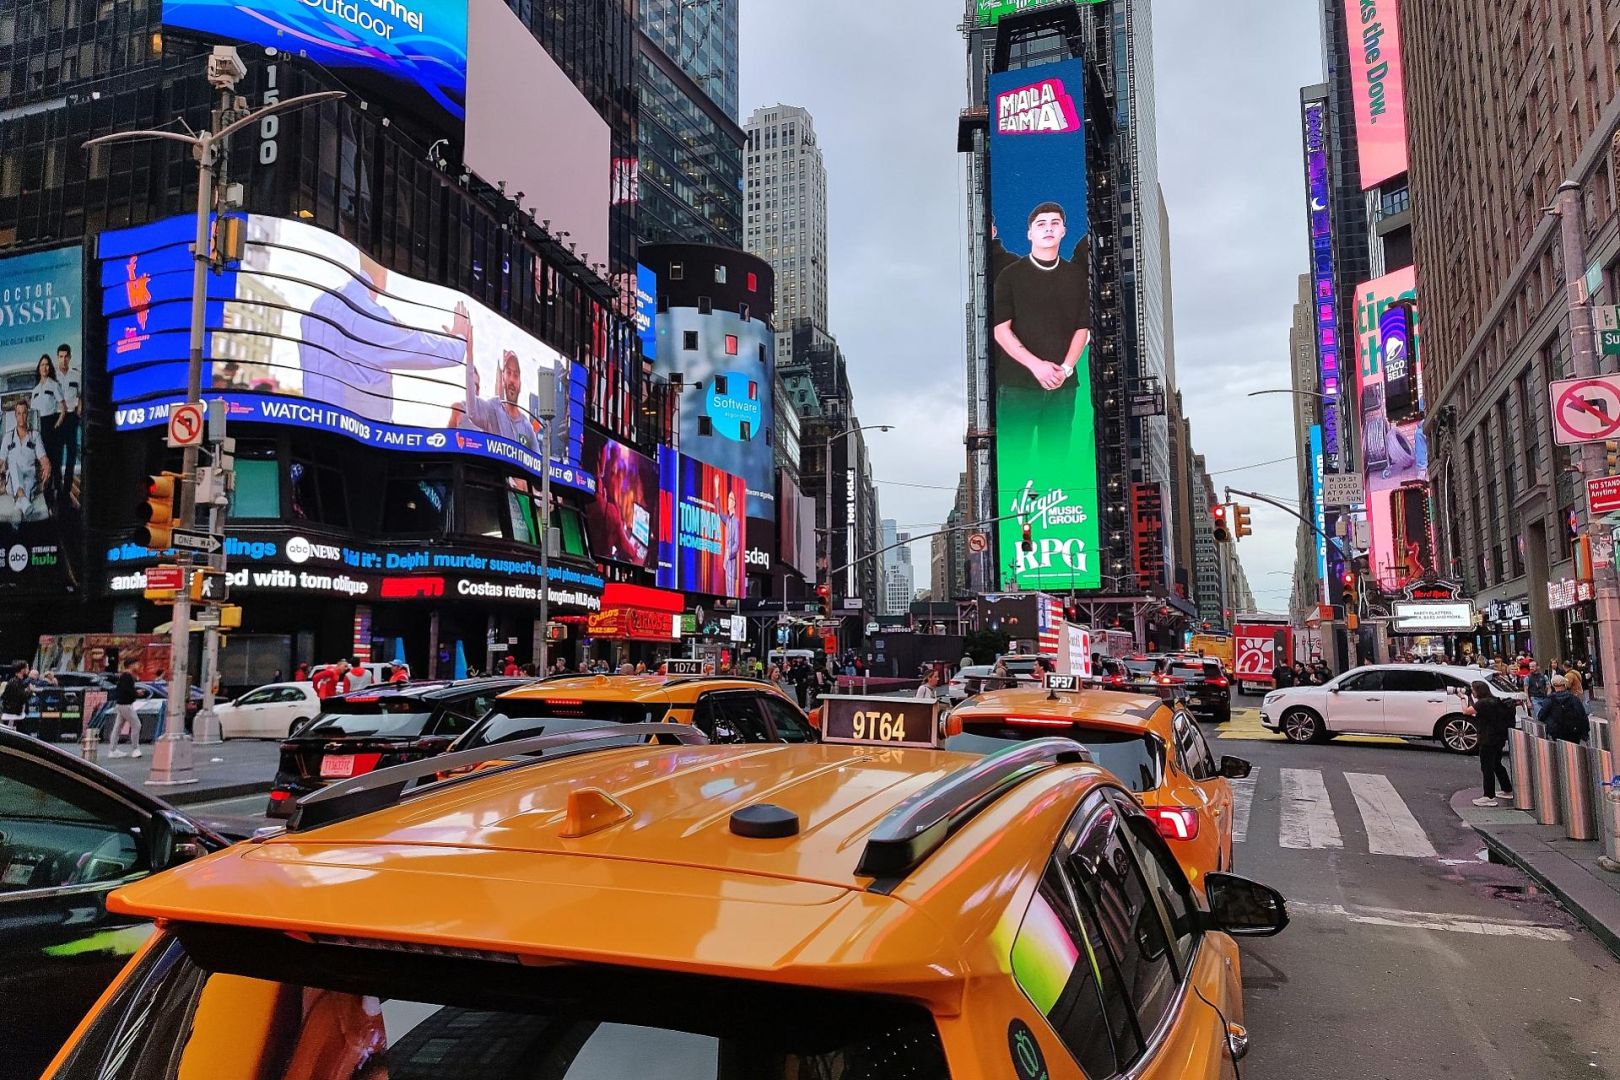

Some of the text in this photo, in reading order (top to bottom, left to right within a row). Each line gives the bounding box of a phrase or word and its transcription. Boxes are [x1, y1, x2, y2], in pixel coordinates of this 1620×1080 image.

[1363, 22, 1384, 64] the
[999, 83, 1055, 119] MALA
[1367, 60, 1388, 125] Dow.
[258, 65, 280, 165] 1500
[1385, 360, 1405, 373] TACO
[1387, 370, 1405, 382] BELL
[714, 396, 757, 414] Software
[129, 408, 145, 425] 03
[261, 401, 322, 423] WATCH
[327, 412, 339, 427] IT
[375, 431, 382, 442] 7
[384, 434, 404, 446] AM
[407, 434, 423, 446] ET
[486, 438, 519, 459] WATCH
[534, 459, 542, 472] 03
[555, 467, 563, 478] ET
[847, 470, 855, 501] LOCKER
[1590, 482, 1599, 490] NO
[1592, 488, 1616, 497] Anytime
[1010, 480, 1067, 529] Virgin
[1049, 505, 1082, 515] MUSIC
[680, 502, 720, 541] TOM PAPA
[1049, 515, 1086, 525] GROUP
[178, 536, 215, 547] ONE WAY
[680, 534, 700, 550] HOME
[10, 552, 26, 561] abc
[32, 553, 57, 565] hulu
[309, 544, 339, 560] NEWS
[1014, 538, 1087, 574] RPG
[386, 552, 428, 572] Delphi
[434, 554, 486, 570] murder
[489, 560, 535, 578] suspect's
[253, 569, 296, 589] with
[299, 572, 331, 590] torn
[332, 574, 368, 596] oblique
[457, 579, 502, 596] Costas
[504, 583, 535, 600] retires
[547, 588, 575, 605] longtime
[575, 592, 587, 606] MLB
[1414, 590, 1450, 599] Hard Rock
[673, 662, 696, 673] 1D74
[853, 712, 904, 740] 9T64
